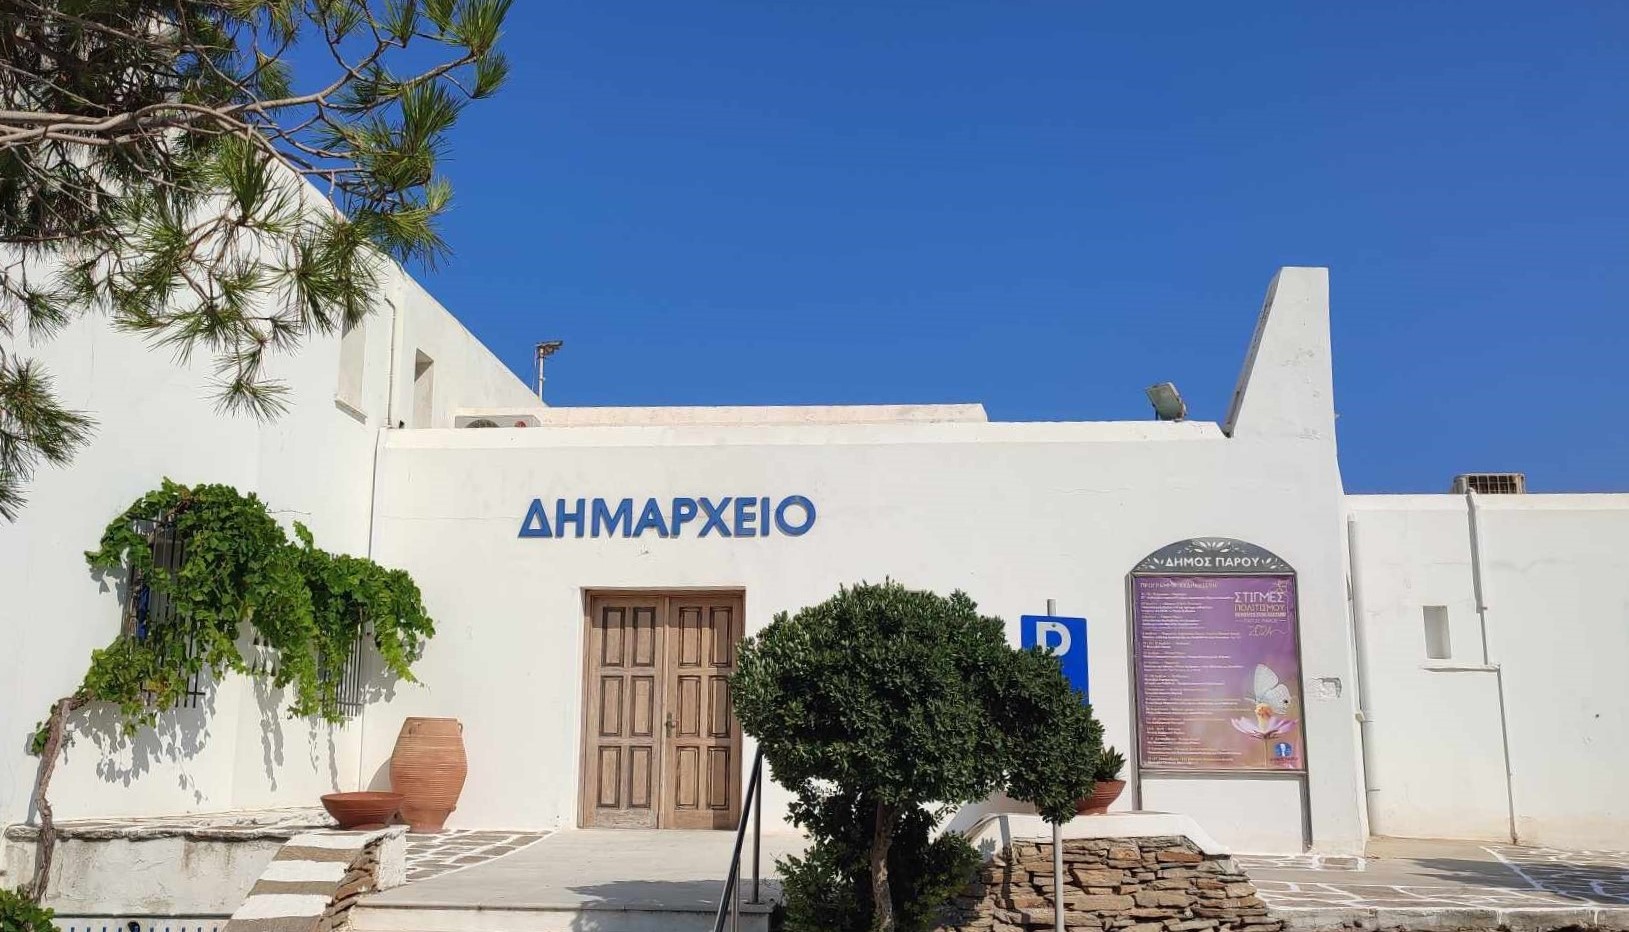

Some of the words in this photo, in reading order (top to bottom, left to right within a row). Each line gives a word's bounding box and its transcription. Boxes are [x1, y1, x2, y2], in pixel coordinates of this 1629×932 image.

[517, 494, 817, 539] ΔΗΜΑΡΧΕΙΟ
[1165, 556, 1212, 567] ΔΗΜΟΣ
[1215, 556, 1260, 567] ΠΑΡΟΥ
[1234, 591, 1286, 603] ΣΤΙΓΜΕΣ
[1234, 603, 1286, 612] ΠΟΛΙΤΙΣΜΟΥ
[1036, 621, 1072, 657] P
